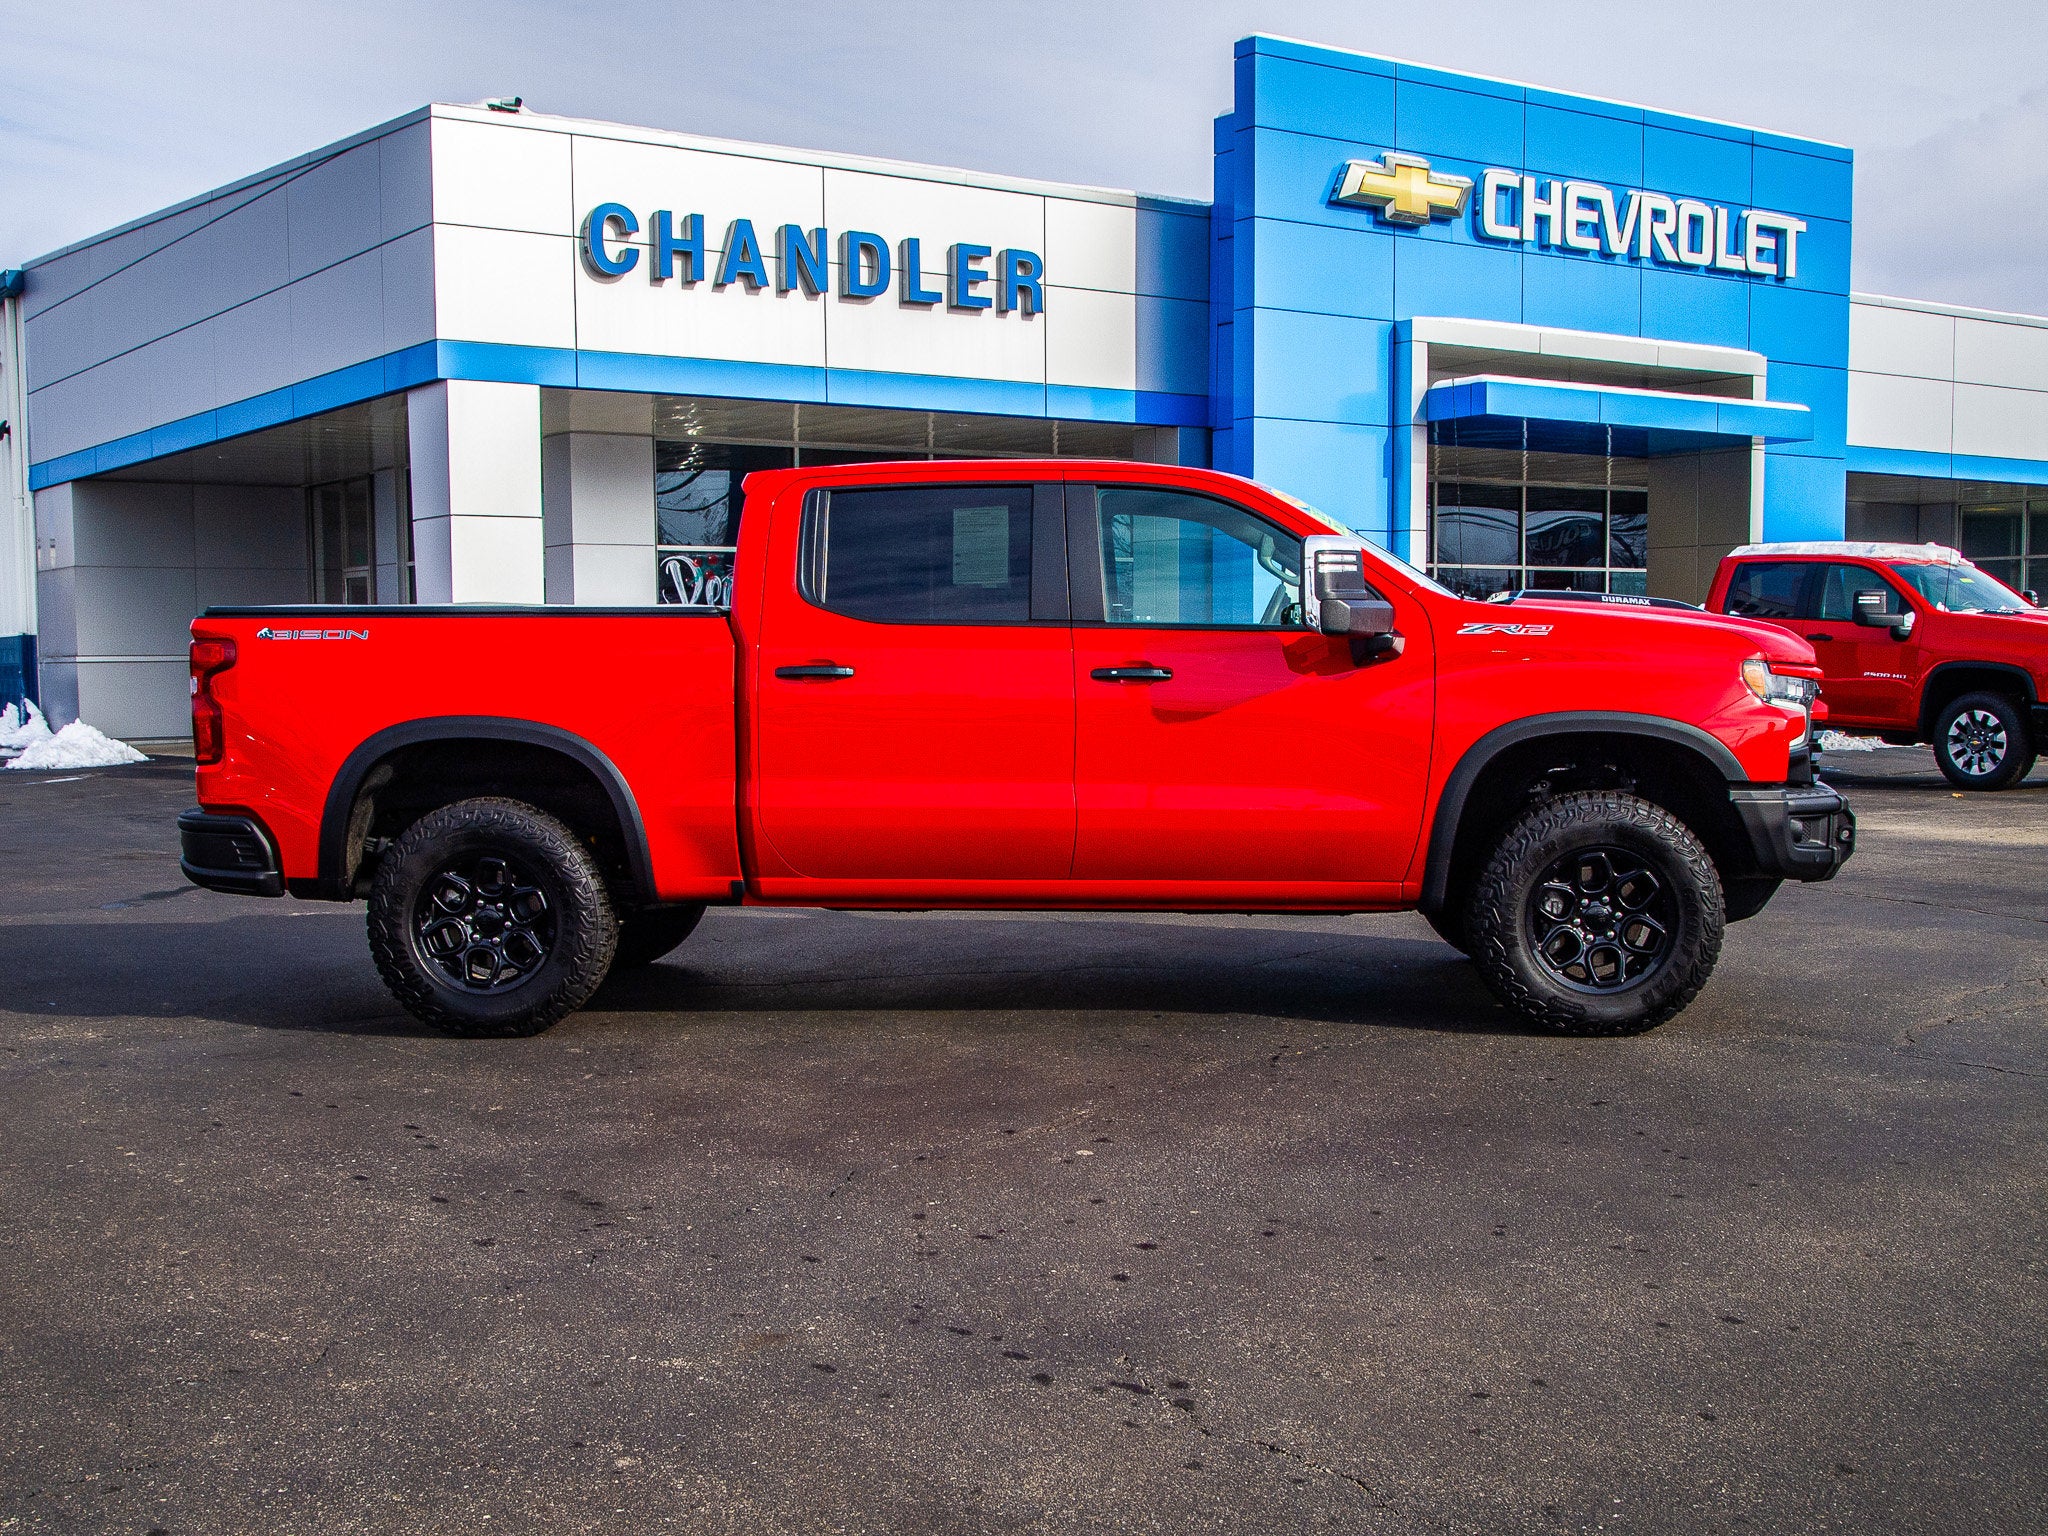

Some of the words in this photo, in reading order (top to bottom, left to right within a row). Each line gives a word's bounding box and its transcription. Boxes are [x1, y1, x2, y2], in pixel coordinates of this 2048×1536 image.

[1475, 168, 1807, 281] CHEVROLET
[579, 202, 1045, 317] CHANDLER
[1600, 594, 1652, 607] DURAMAX
[271, 629, 370, 641] BISON
[1456, 622, 1555, 637] ZR2
[1863, 671, 1891, 679] 2500
